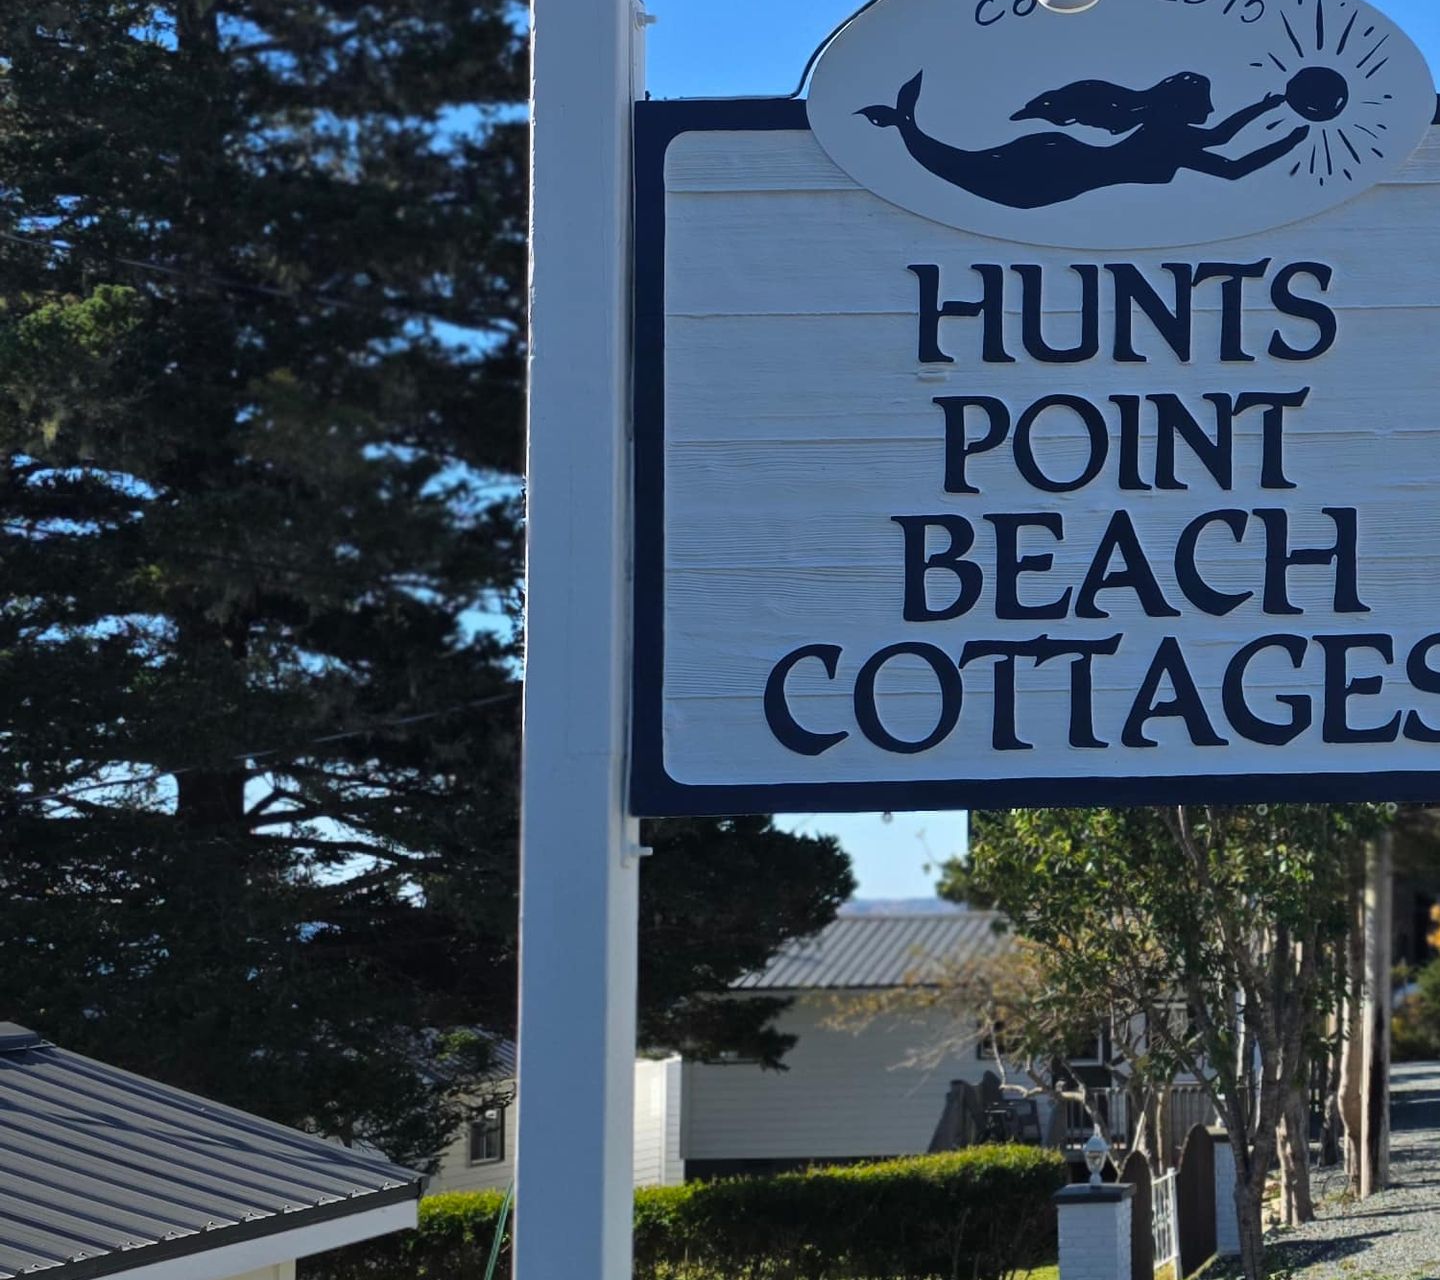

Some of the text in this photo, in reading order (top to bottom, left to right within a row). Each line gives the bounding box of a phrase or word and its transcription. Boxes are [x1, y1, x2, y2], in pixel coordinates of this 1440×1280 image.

[907, 257, 1337, 364] HUNTS
[932, 386, 1311, 494] POINT
[890, 507, 1371, 623] BEACH
